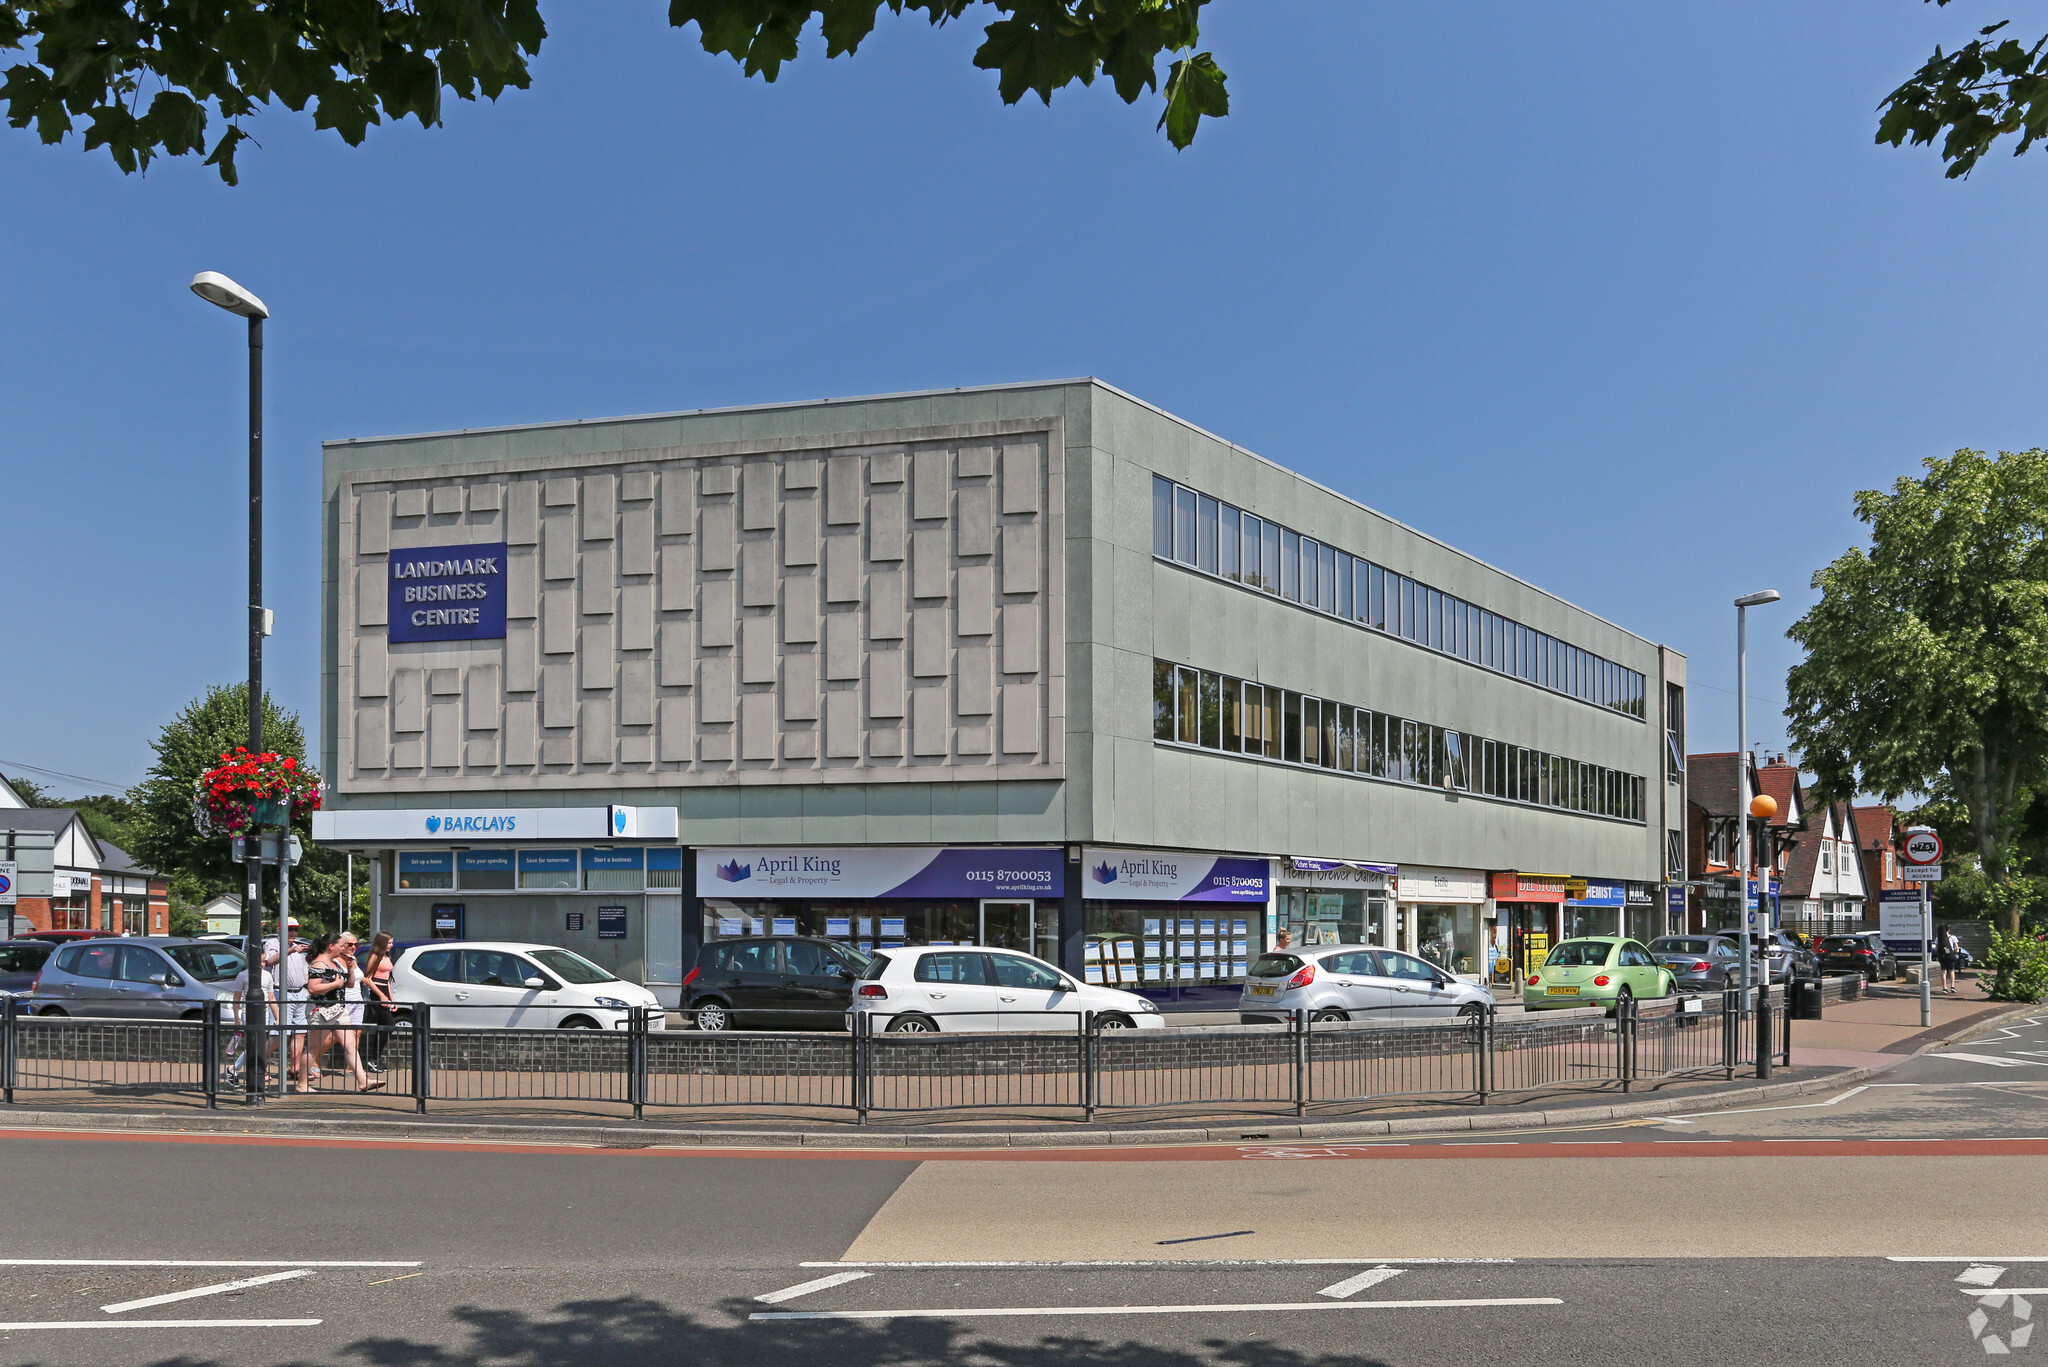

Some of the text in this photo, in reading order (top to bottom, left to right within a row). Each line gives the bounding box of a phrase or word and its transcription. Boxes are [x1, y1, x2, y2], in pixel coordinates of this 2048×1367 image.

[395, 557, 498, 579] LANDMARK
[405, 582, 487, 602] BUSINESS
[411, 607, 479, 627] CENTRE
[444, 816, 516, 831] BARCLAYS
[756, 856, 841, 876] April King
[1120, 858, 1178, 879] April King
[769, 877, 788, 886] Legal
[797, 877, 828, 886] Property
[966, 869, 1052, 882] 0115 8700053
[1129, 879, 1142, 888] Legal
[1148, 880, 1169, 888] Property
[1213, 876, 1263, 888] 0115 8700053
[1283, 863, 1313, 888] Henry
[1354, 868, 1384, 890] Gallery
[1519, 877, 1535, 892] DEE
[1537, 877, 1566, 893] STORES
[1586, 885, 1613, 899] HEMIST
